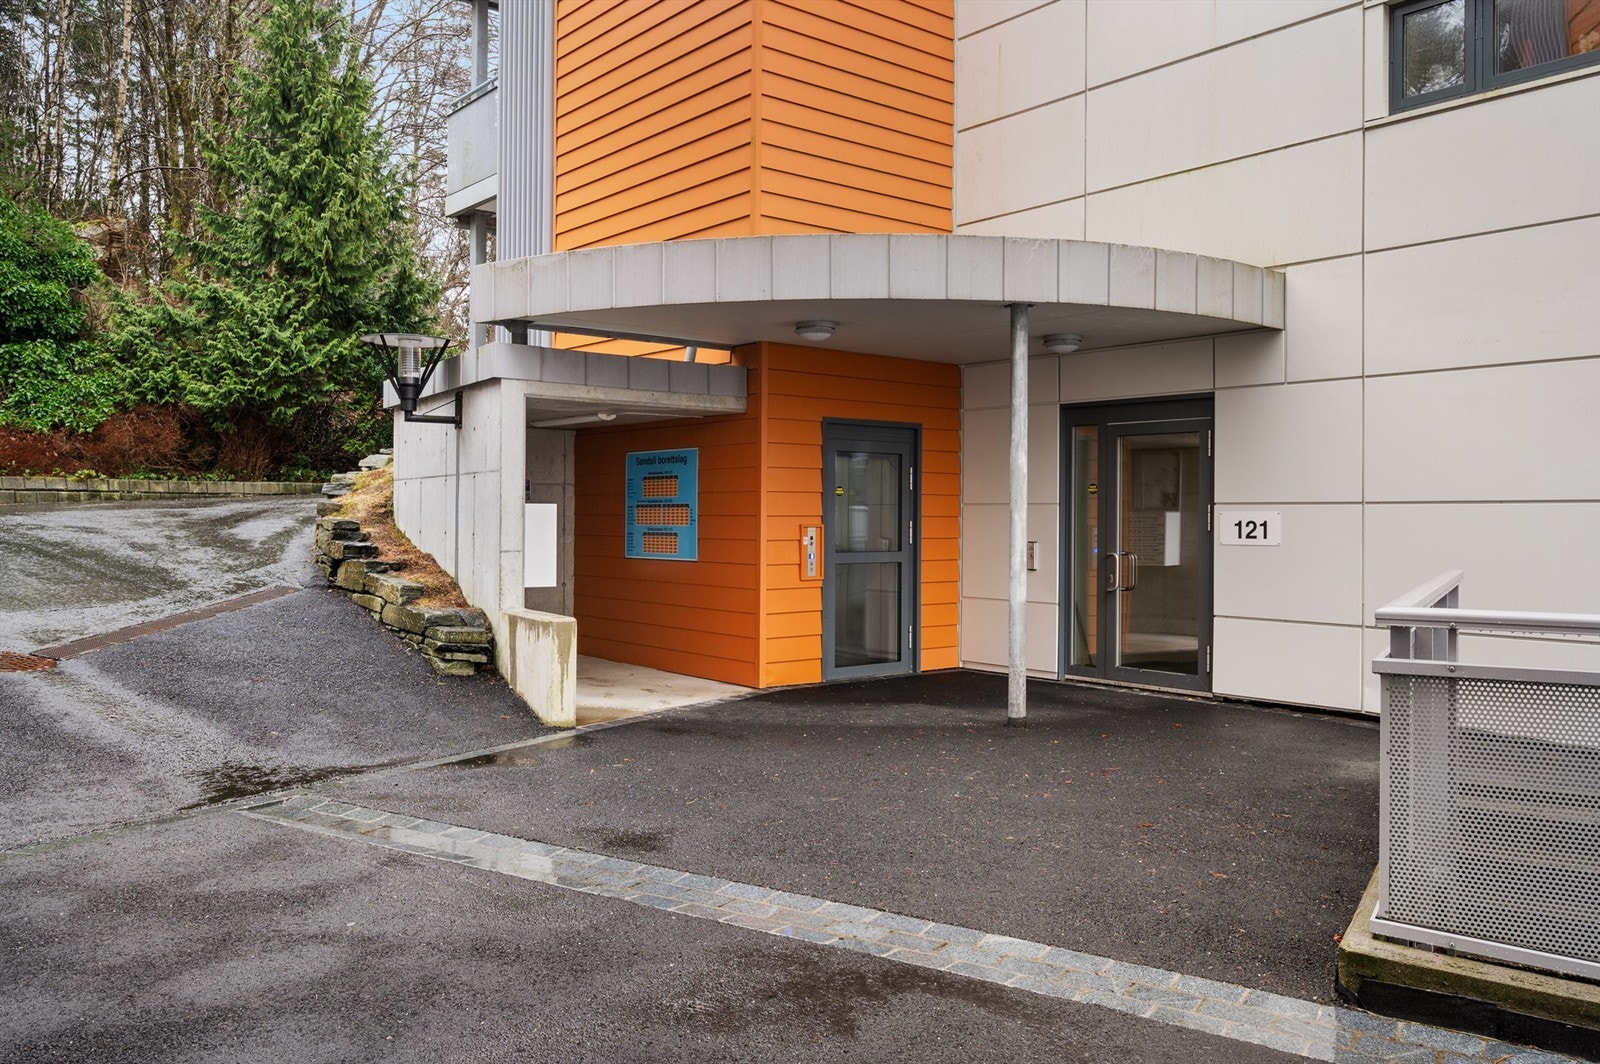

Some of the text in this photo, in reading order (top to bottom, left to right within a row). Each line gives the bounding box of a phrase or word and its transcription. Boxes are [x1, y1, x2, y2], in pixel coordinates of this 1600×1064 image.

[635, 455, 687, 465] Sandsli borettslag
[1234, 520, 1267, 539] 121
